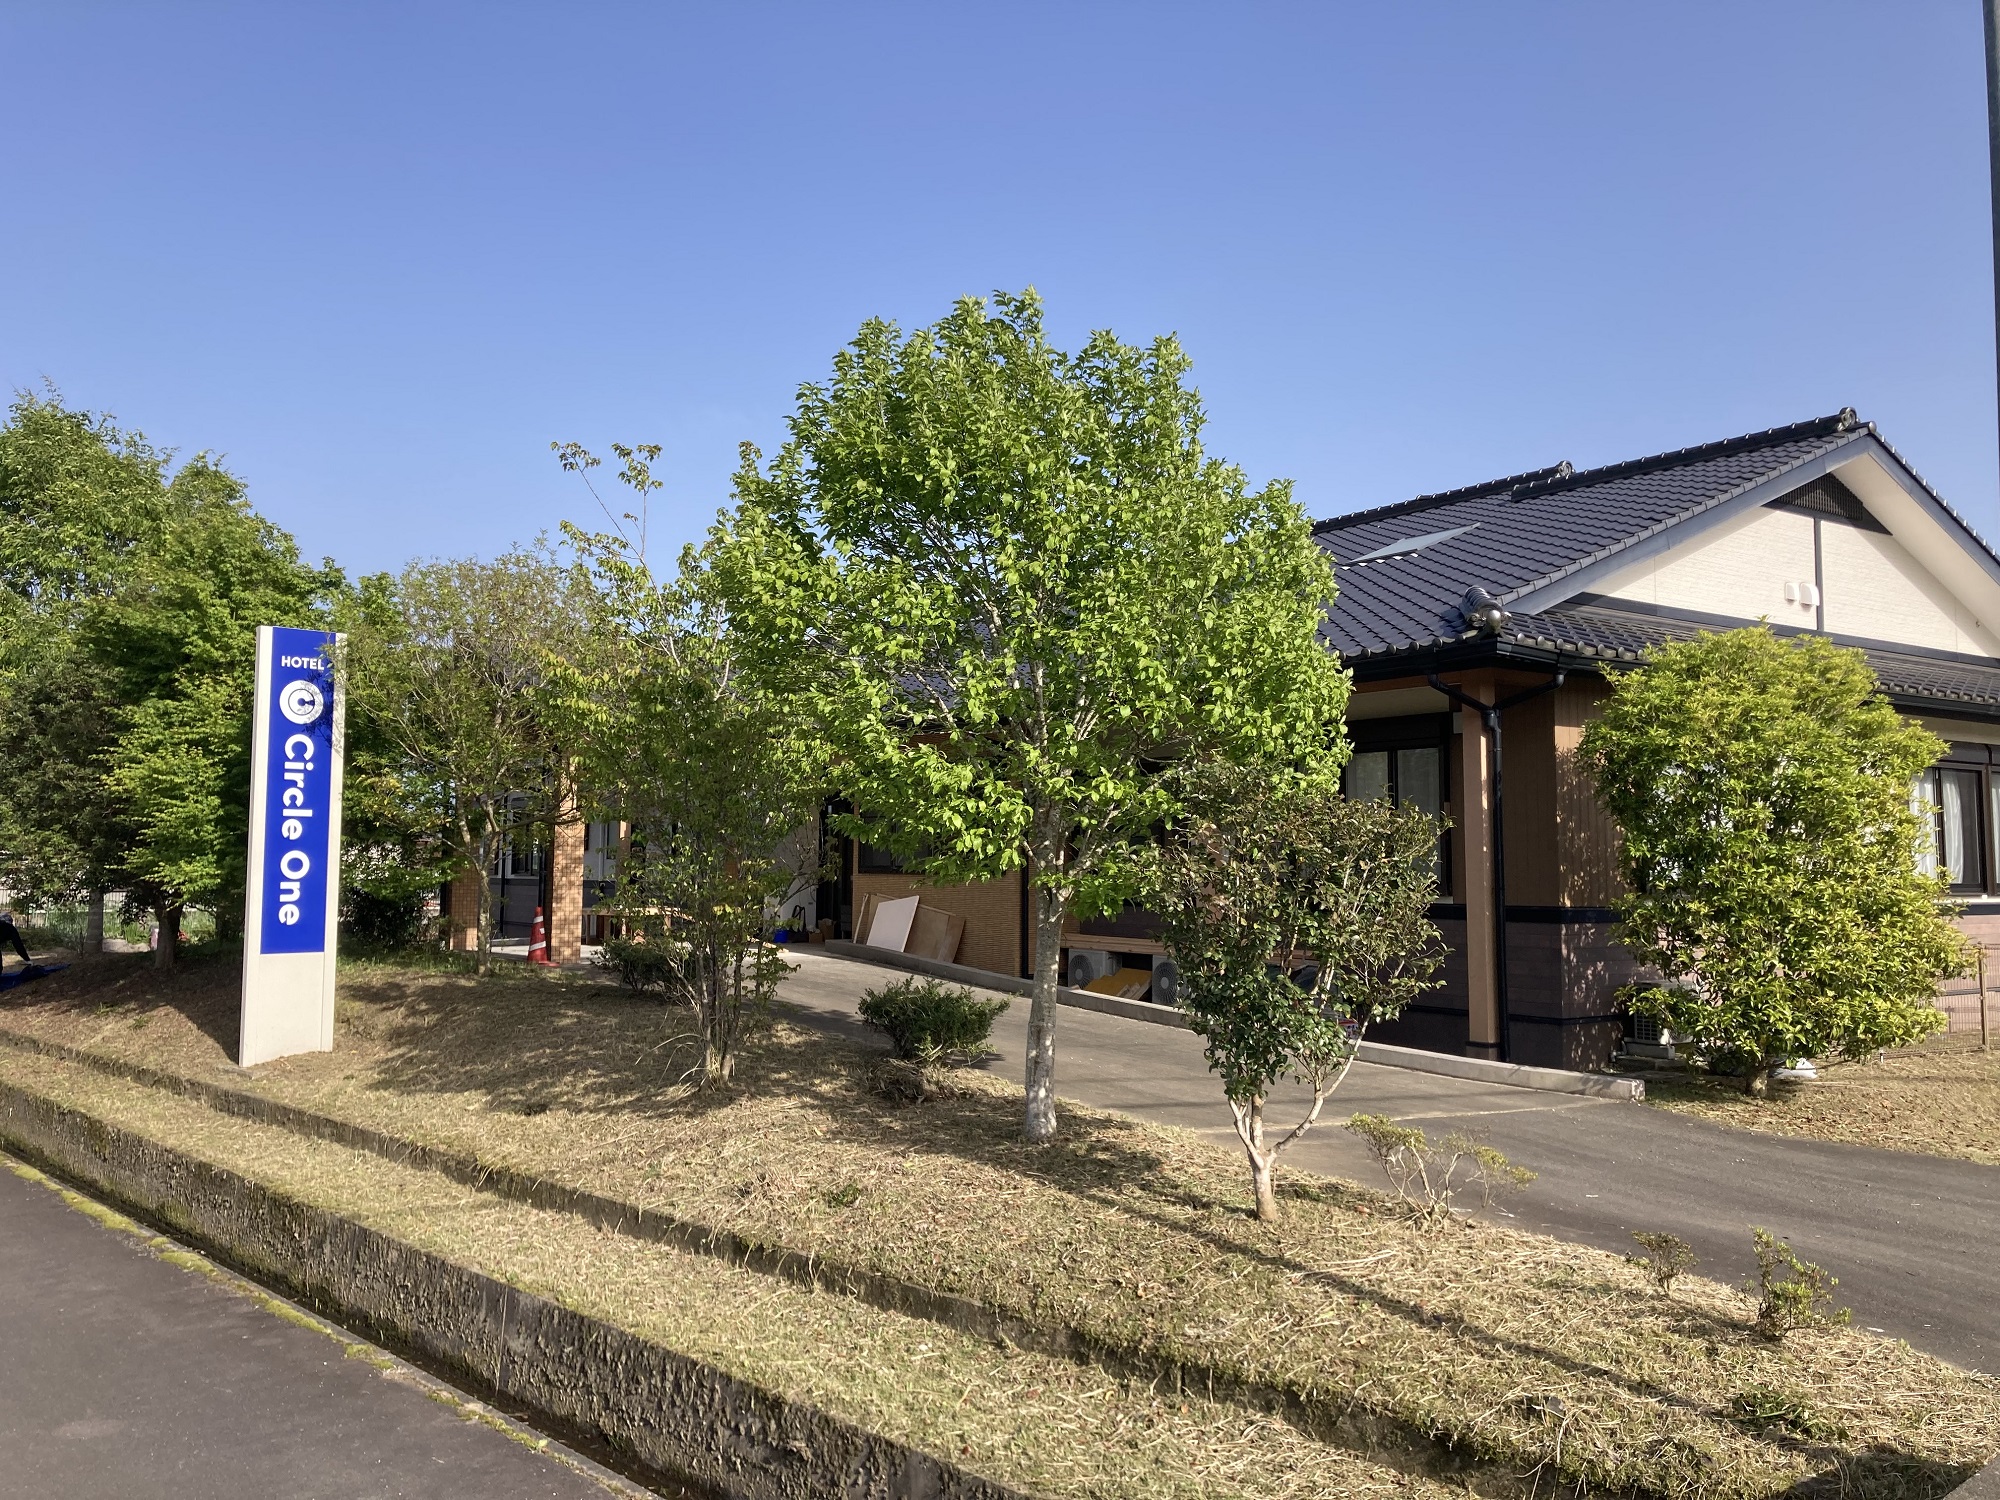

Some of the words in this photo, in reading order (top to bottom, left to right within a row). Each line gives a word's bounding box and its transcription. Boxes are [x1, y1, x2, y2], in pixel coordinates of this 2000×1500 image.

[281, 655, 325, 671] HOTEL
[281, 733, 315, 840] Circle
[278, 849, 311, 926] One
